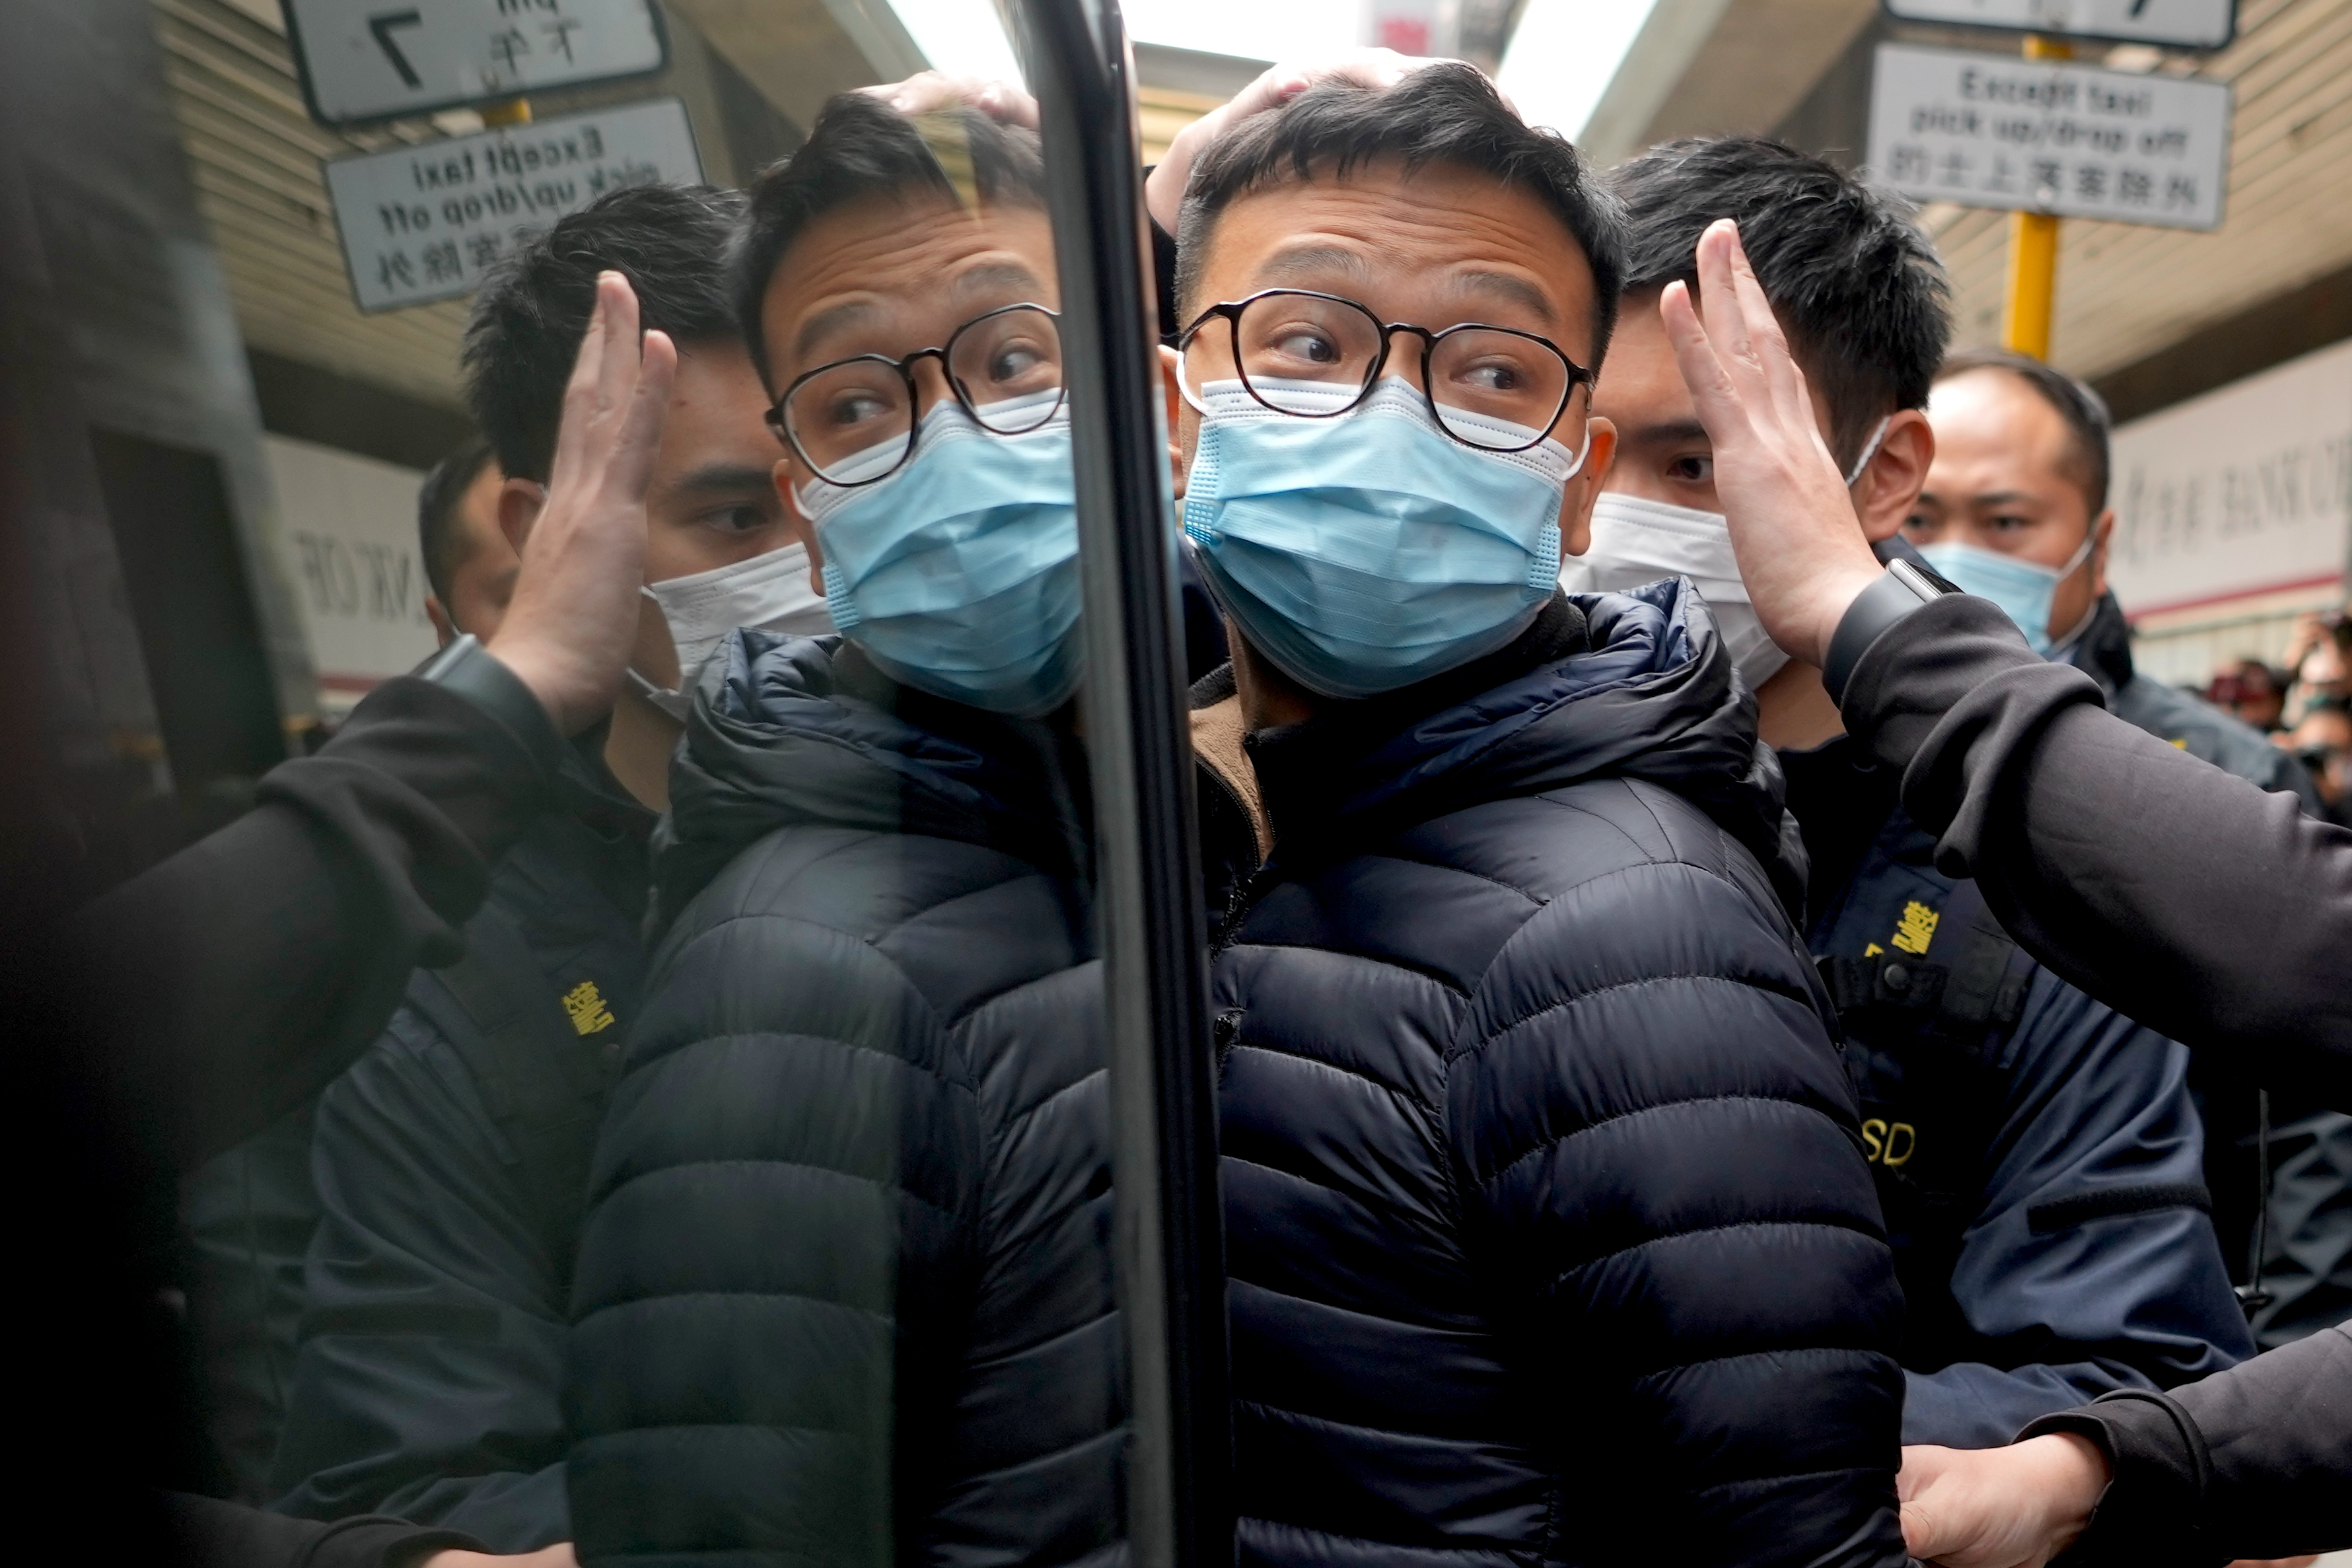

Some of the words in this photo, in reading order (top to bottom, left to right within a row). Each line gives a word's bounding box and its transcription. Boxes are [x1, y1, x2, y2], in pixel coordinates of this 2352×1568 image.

[1959, 67, 2079, 104] Except
[2088, 87, 2153, 115] taxi
[1910, 106, 1981, 137] pick
[2137, 129, 2190, 157] off
